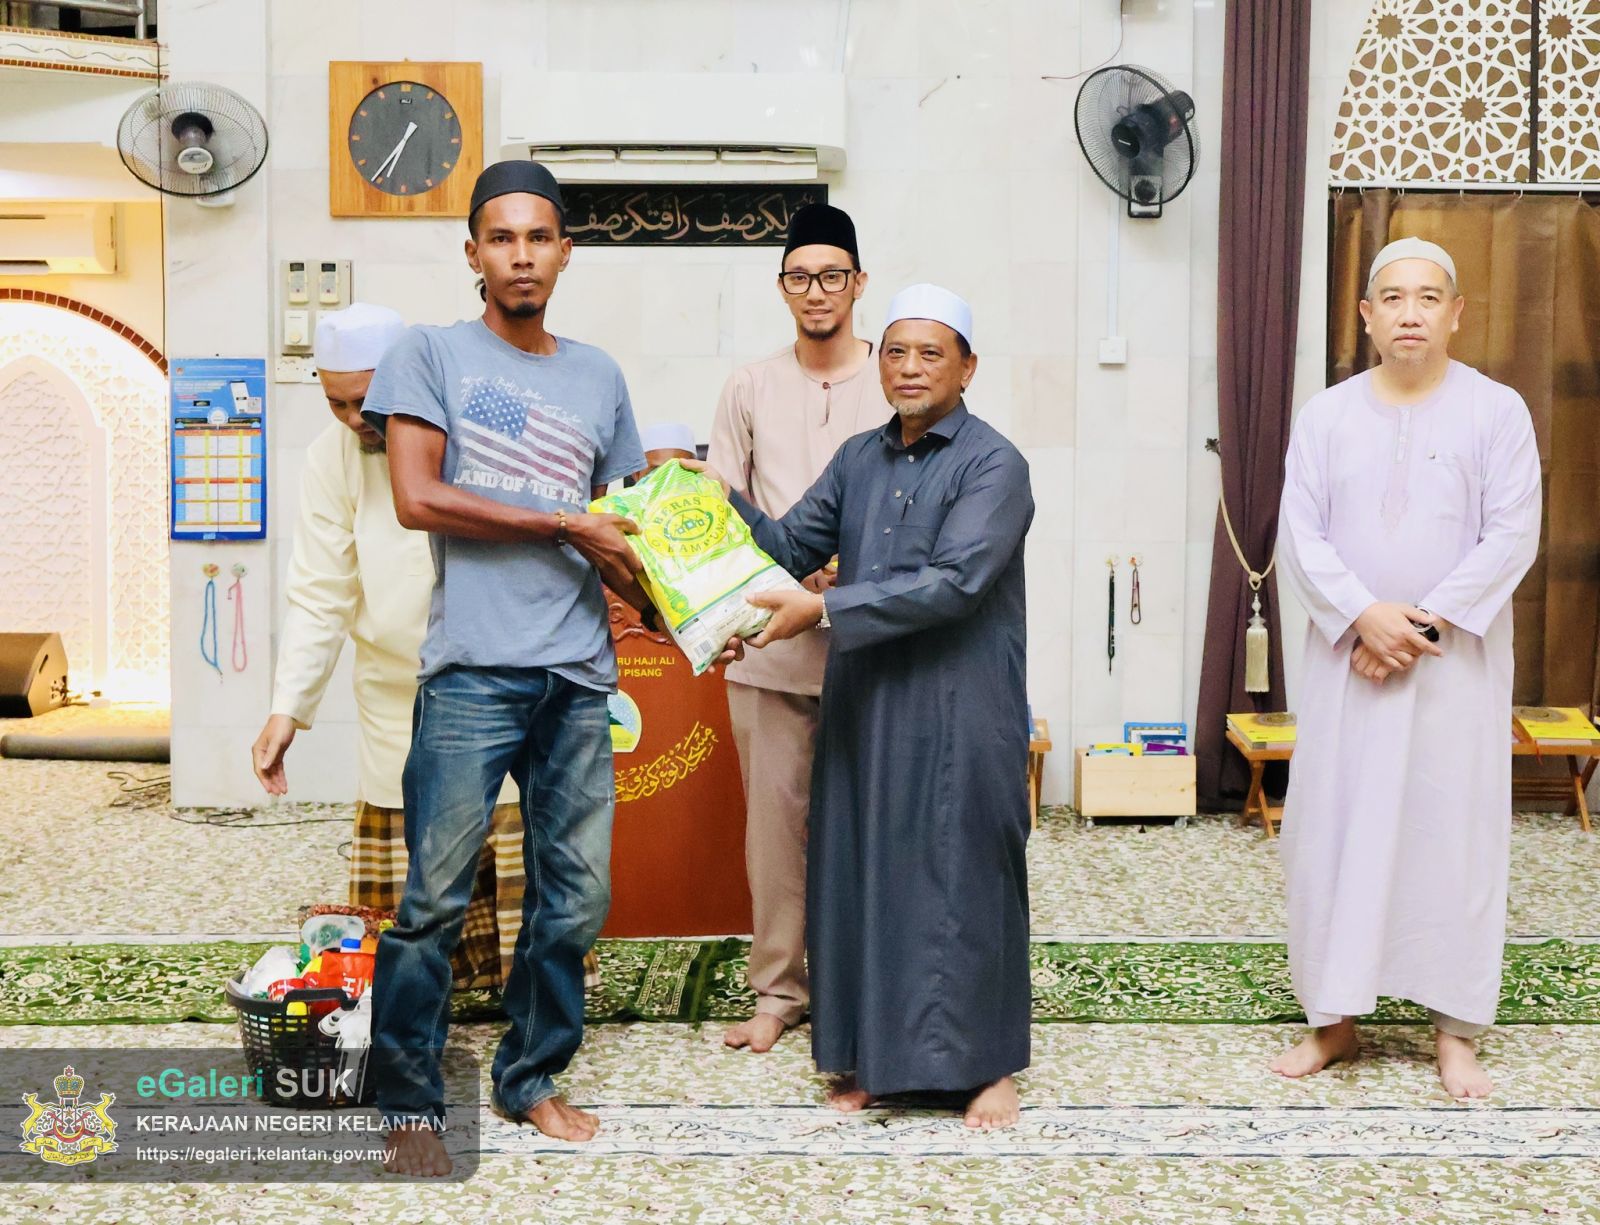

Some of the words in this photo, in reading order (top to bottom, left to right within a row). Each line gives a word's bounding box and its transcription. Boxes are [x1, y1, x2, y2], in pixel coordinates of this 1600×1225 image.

[453, 469, 498, 488] AND
[501, 476, 527, 492] OF
[653, 496, 702, 525] BERAS
[617, 657, 631, 666] RU
[634, 657, 656, 666] HAJI
[659, 657, 675, 665] ALI
[624, 668, 662, 677] PISANG
